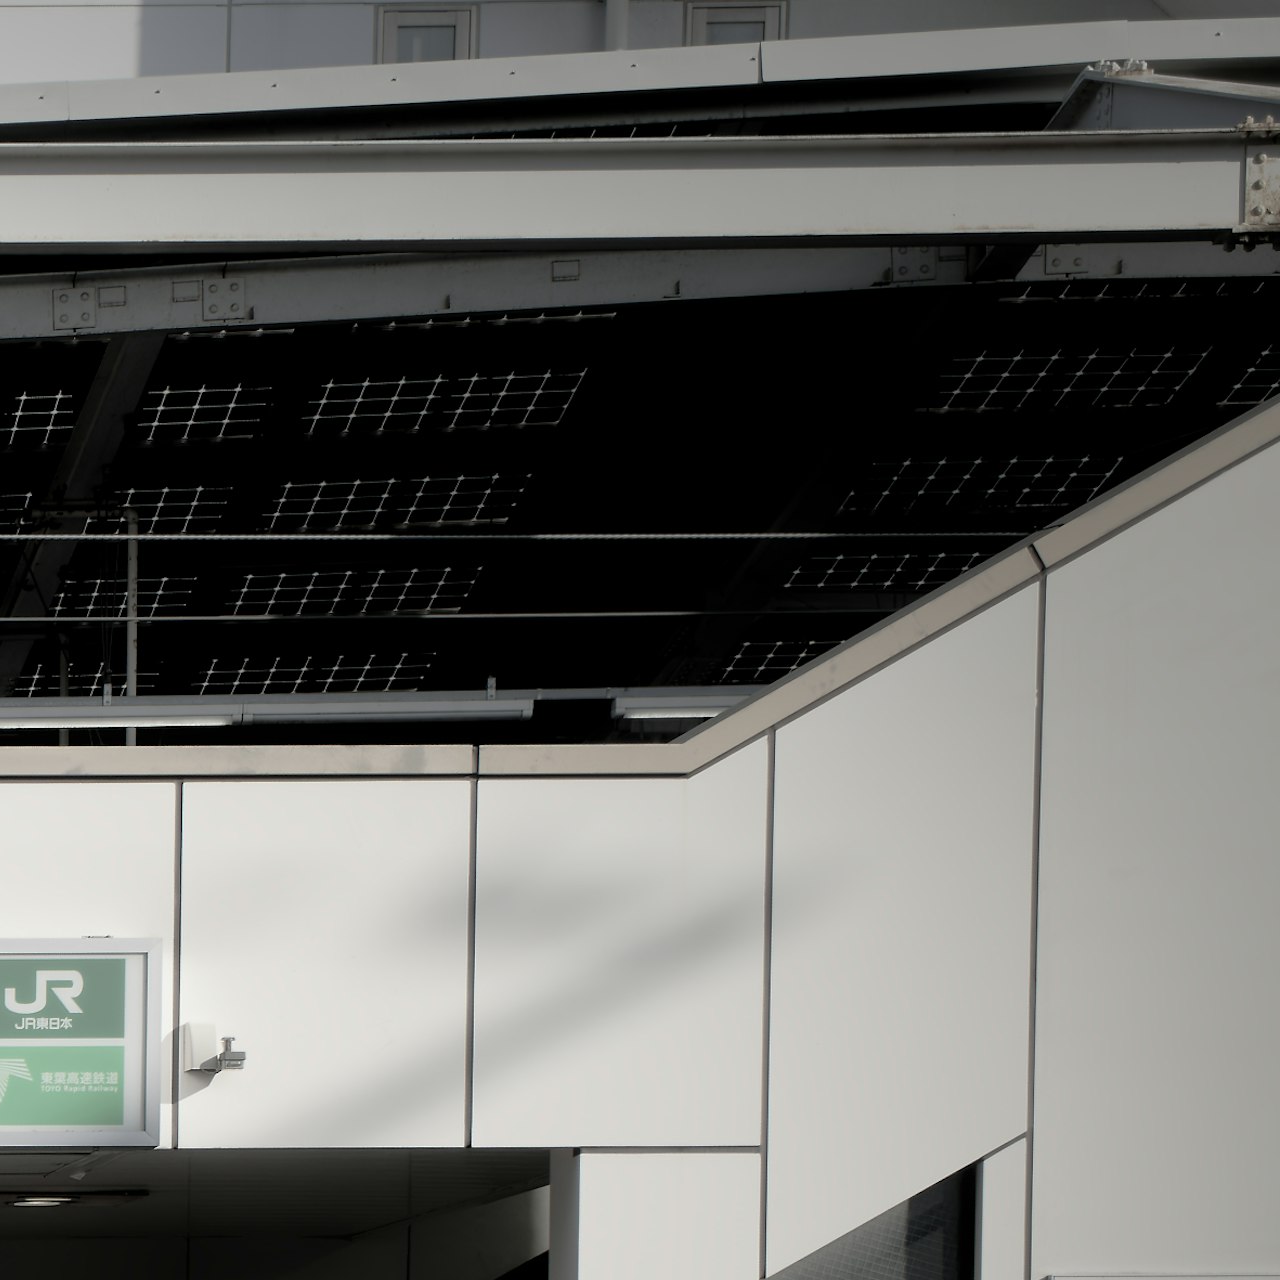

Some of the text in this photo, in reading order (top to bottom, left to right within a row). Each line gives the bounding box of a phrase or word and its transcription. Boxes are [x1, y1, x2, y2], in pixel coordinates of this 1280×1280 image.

[4, 970, 84, 1014] JR
[15, 1017, 73, 1030] JR東日本
[41, 1071, 119, 1085] 東葉高速鉄道
[63, 1085, 87, 1094] Rapid
[88, 1085, 119, 1094] Railway
